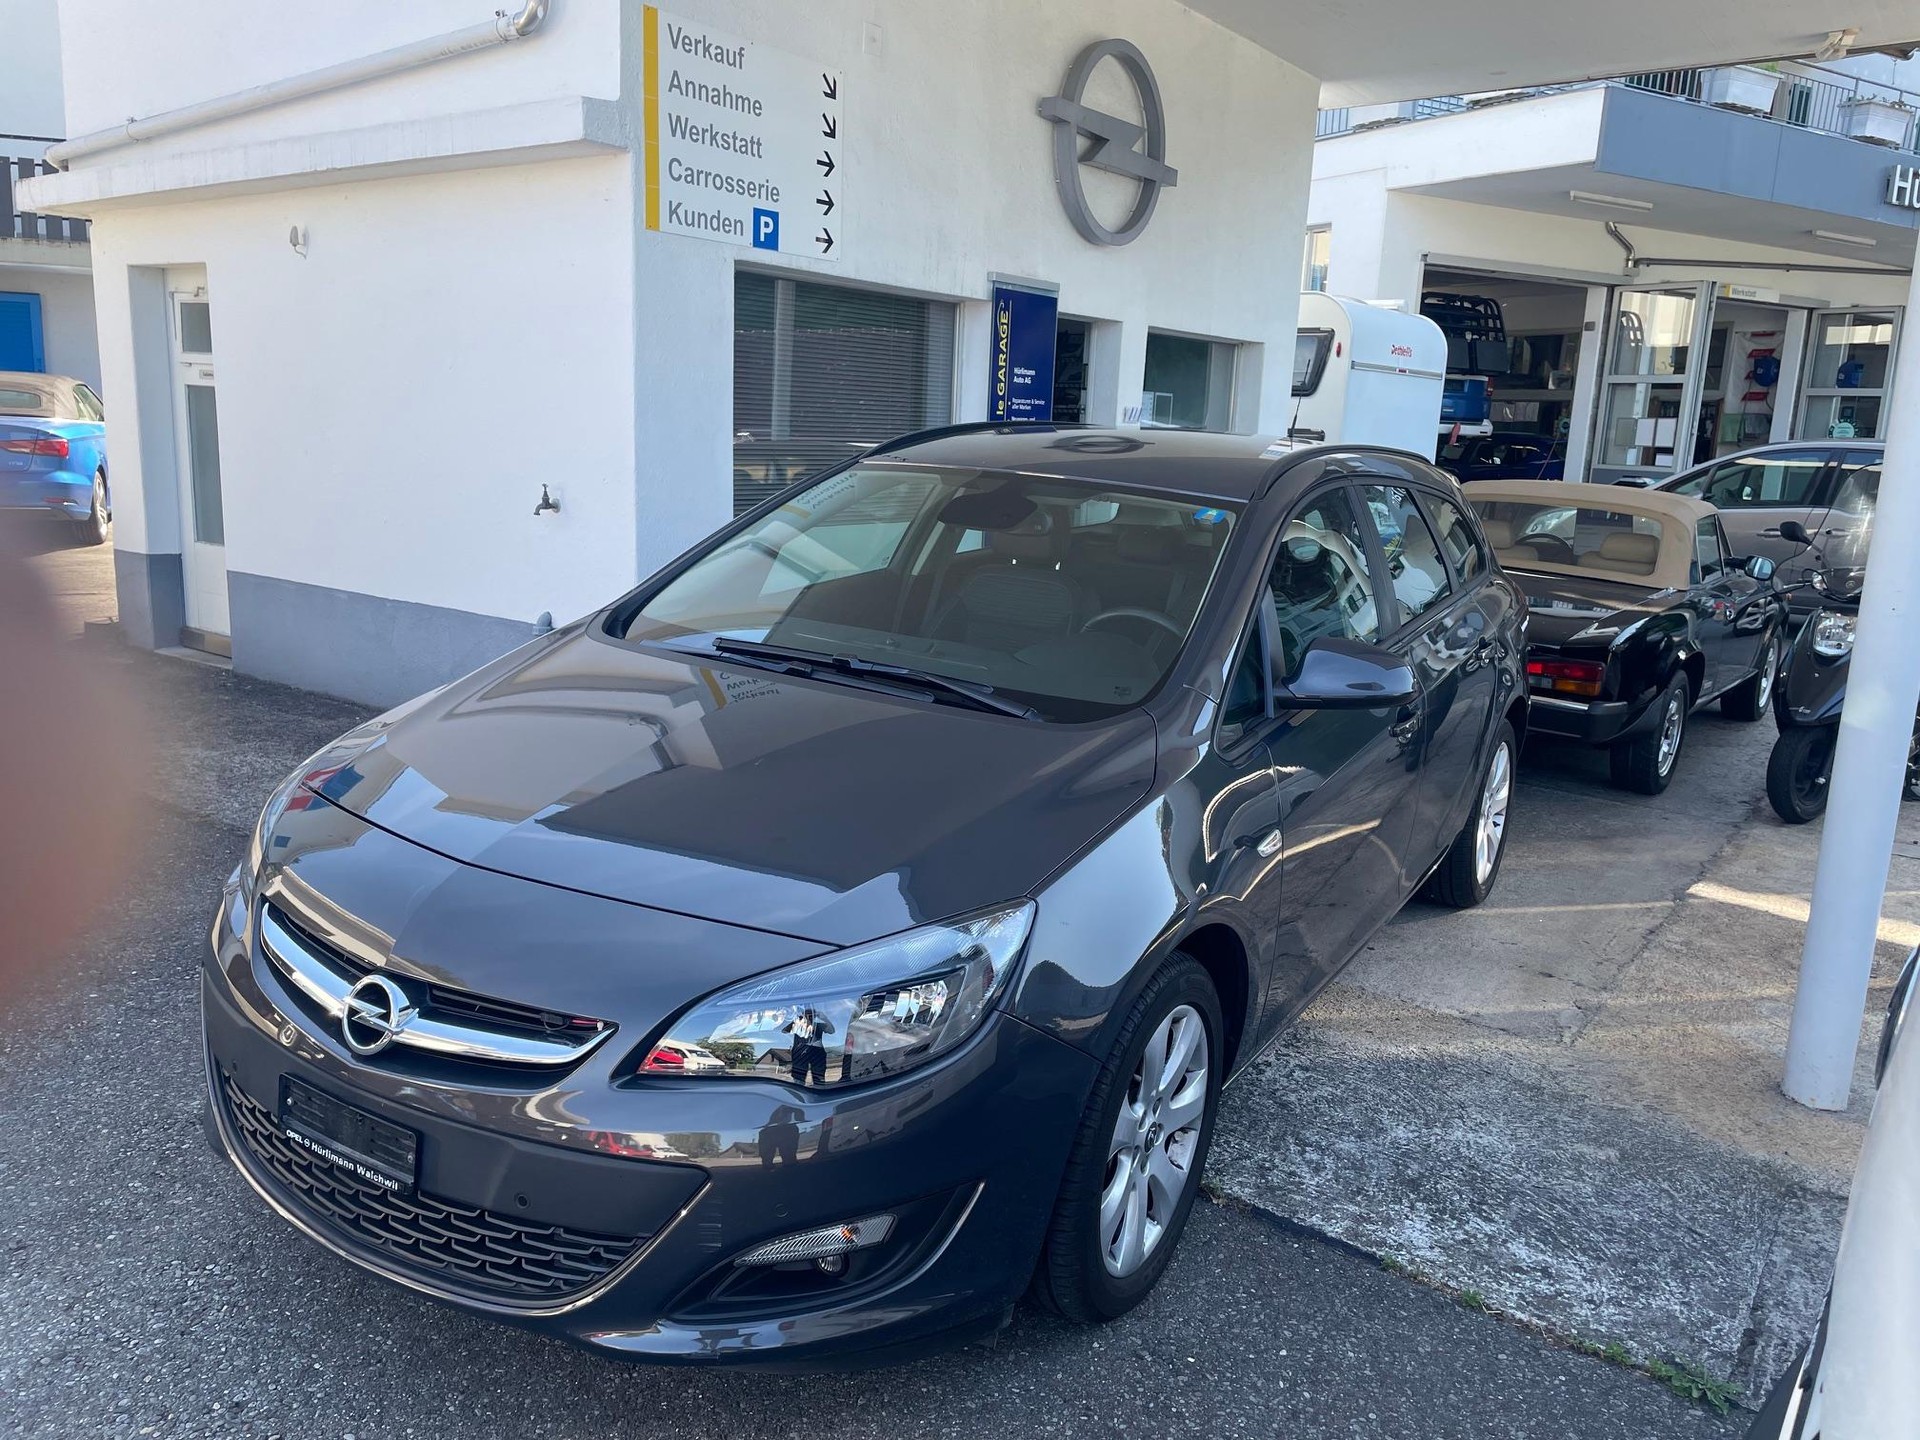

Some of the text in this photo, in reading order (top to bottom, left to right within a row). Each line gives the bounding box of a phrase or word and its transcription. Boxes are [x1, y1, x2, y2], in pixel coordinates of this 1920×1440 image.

[667, 23, 745, 70] Verkauf
[668, 70, 763, 117] Annahme
[667, 112, 763, 159] Werkstatt
[668, 157, 780, 203] Carrosserie
[668, 200, 744, 237] Kunden
[996, 310, 1009, 415] le GARAGE
[1013, 376, 1024, 384] Auto
[286, 1129, 399, 1192] OPEL Hürlimann Walchwil
